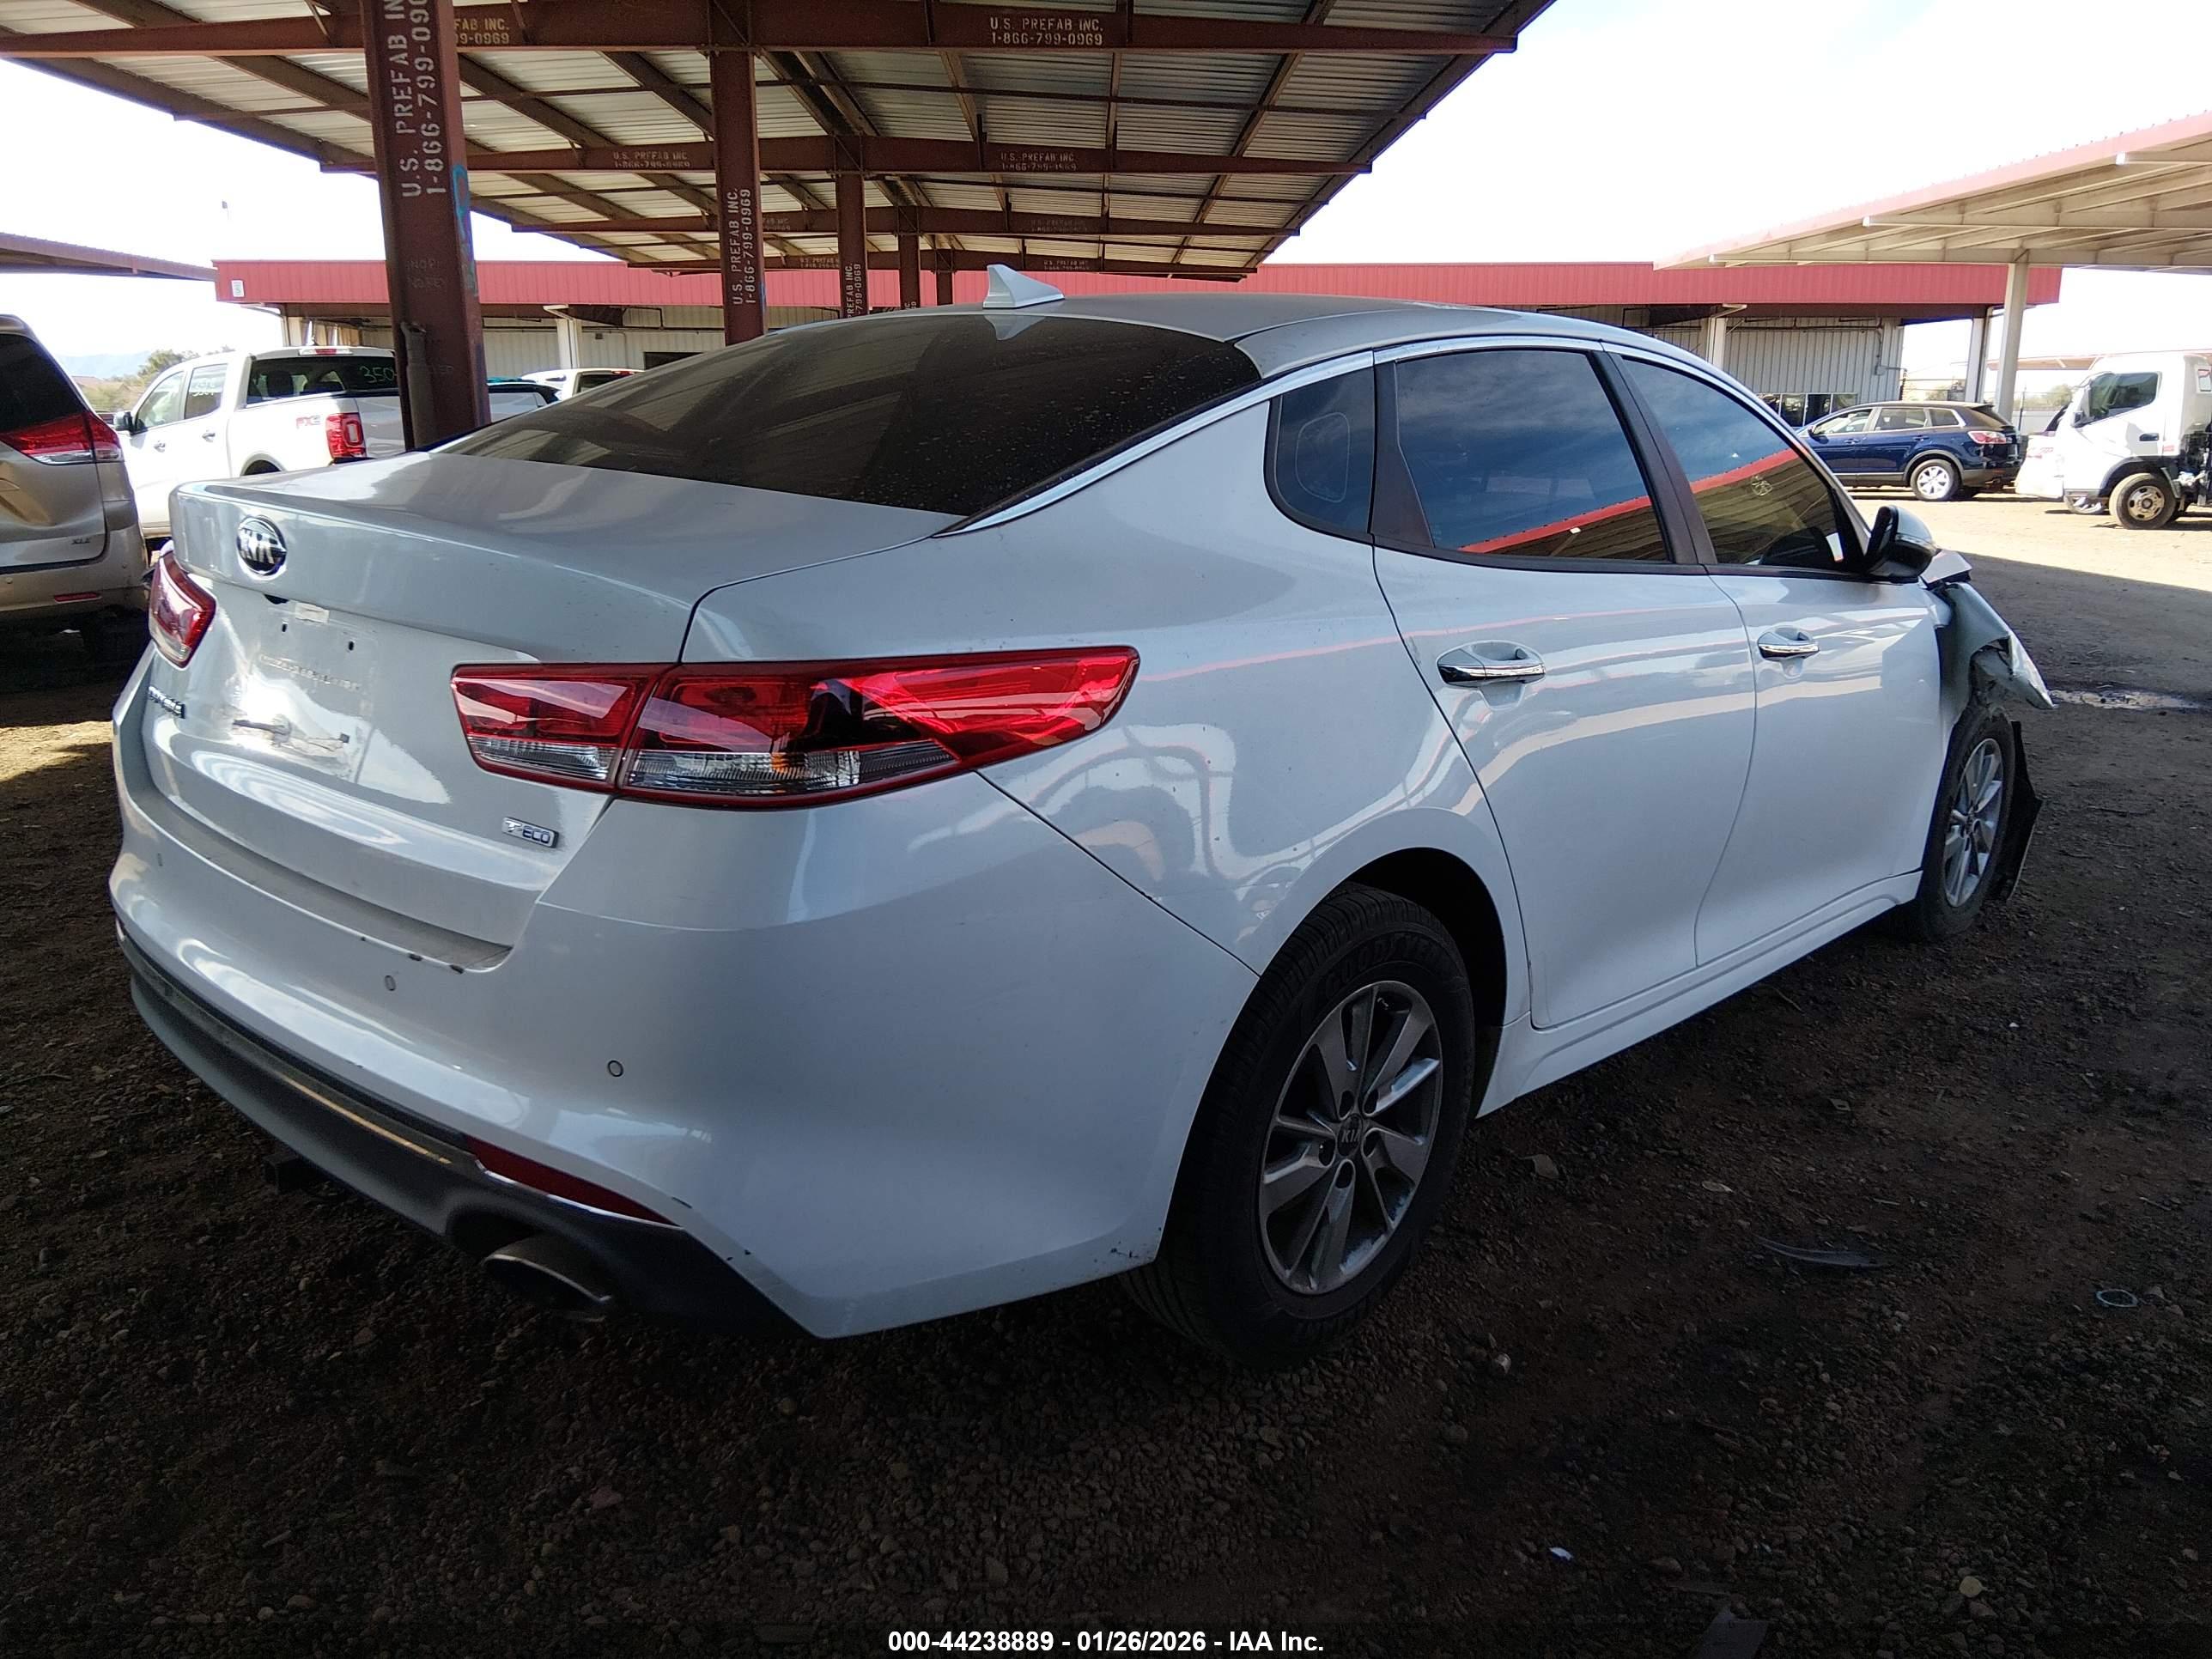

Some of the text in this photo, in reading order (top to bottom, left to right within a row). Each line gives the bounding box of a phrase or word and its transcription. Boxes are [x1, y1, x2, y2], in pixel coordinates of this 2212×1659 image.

[484, 18, 509, 30] INC.
[990, 17, 1104, 32] U.S. PREFAB INC.
[992, 32, 1103, 46] 1-866-799-0969
[387, 34, 416, 134] PREFAB
[400, 149, 422, 198] U.S.
[727, 188, 744, 305] U.S. PREFAB INC.
[740, 189, 756, 304] 1-866-799-0969
[237, 526, 282, 565] KIA
[1341, 1128, 1362, 1144] KIA
